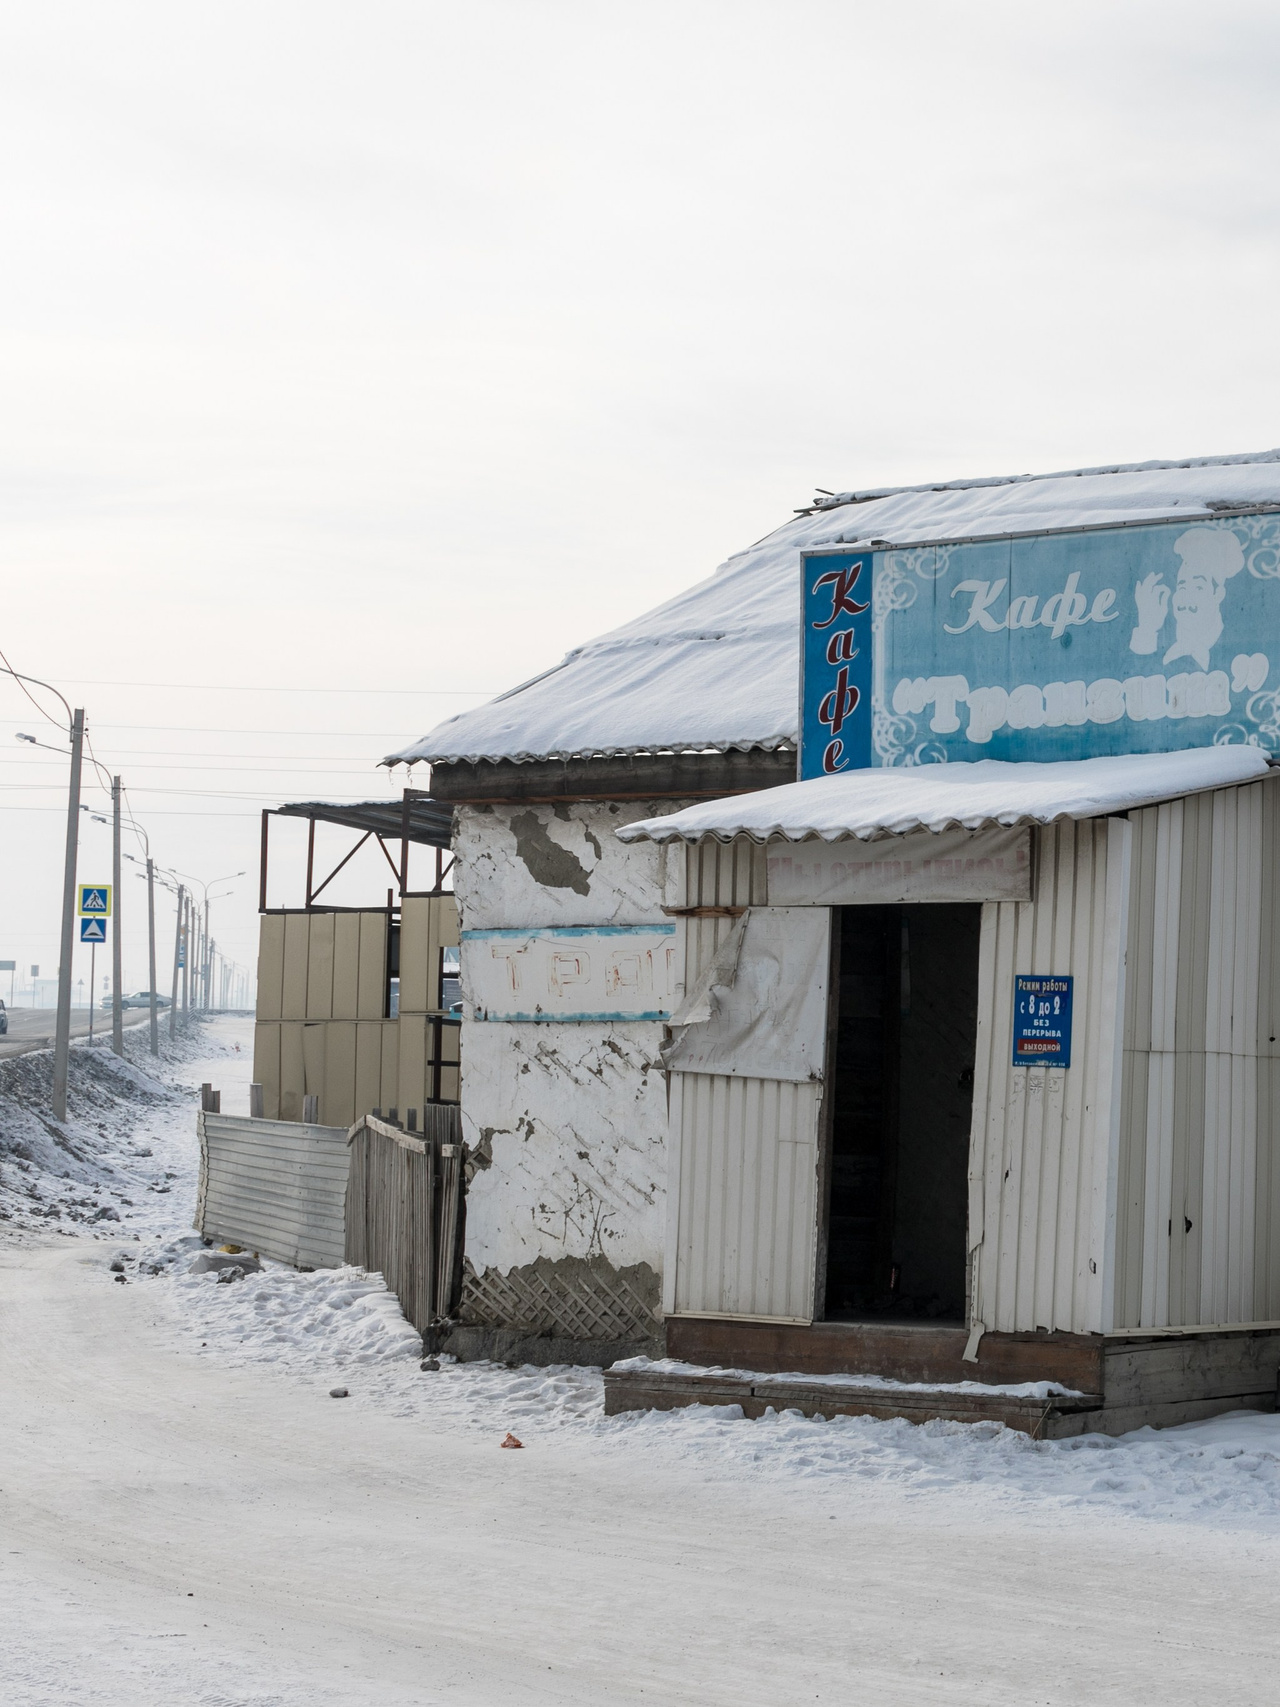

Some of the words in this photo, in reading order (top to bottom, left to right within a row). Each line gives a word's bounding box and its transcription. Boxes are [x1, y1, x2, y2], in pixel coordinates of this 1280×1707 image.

[943, 570, 1120, 640] Кафе
[812, 561, 870, 774] Кафе
[1018, 978, 1040, 991] Режим
[1042, 978, 1068, 993] работы
[1028, 994, 1035, 1014] 8
[1038, 1001, 1050, 1017] до
[1033, 1019, 1050, 1027] БЕЗ
[1022, 1028, 1062, 1038] ПЕРЕРЫВА
